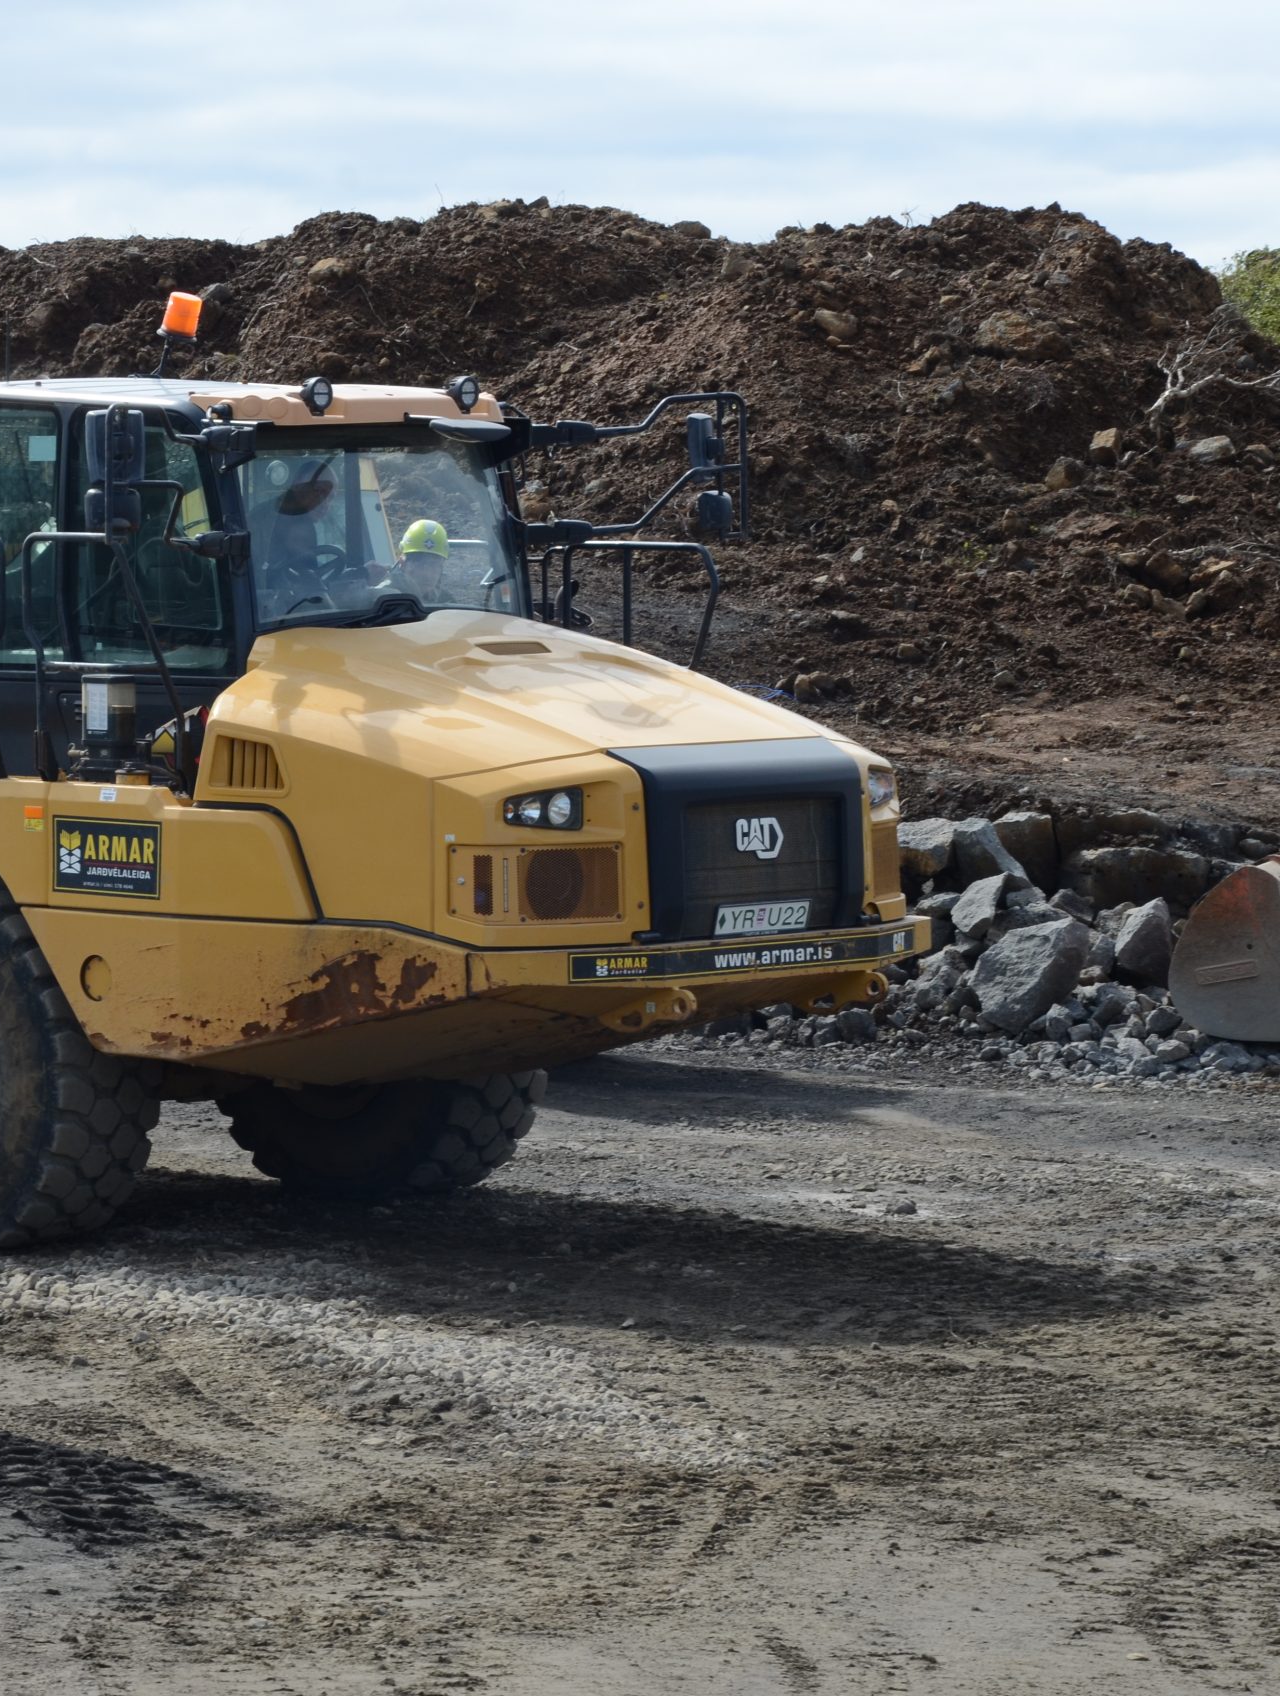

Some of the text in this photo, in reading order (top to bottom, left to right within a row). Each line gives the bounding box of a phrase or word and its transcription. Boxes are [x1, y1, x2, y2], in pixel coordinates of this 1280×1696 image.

[735, 816, 776, 853] CAT
[84, 834, 155, 864] ARMAR
[86, 867, 151, 880] JARÐVÉLALEIGA
[732, 910, 755, 929] YR
[767, 905, 807, 926] U22
[610, 957, 648, 969] ARMAR
[714, 946, 833, 968] www.armar.is
